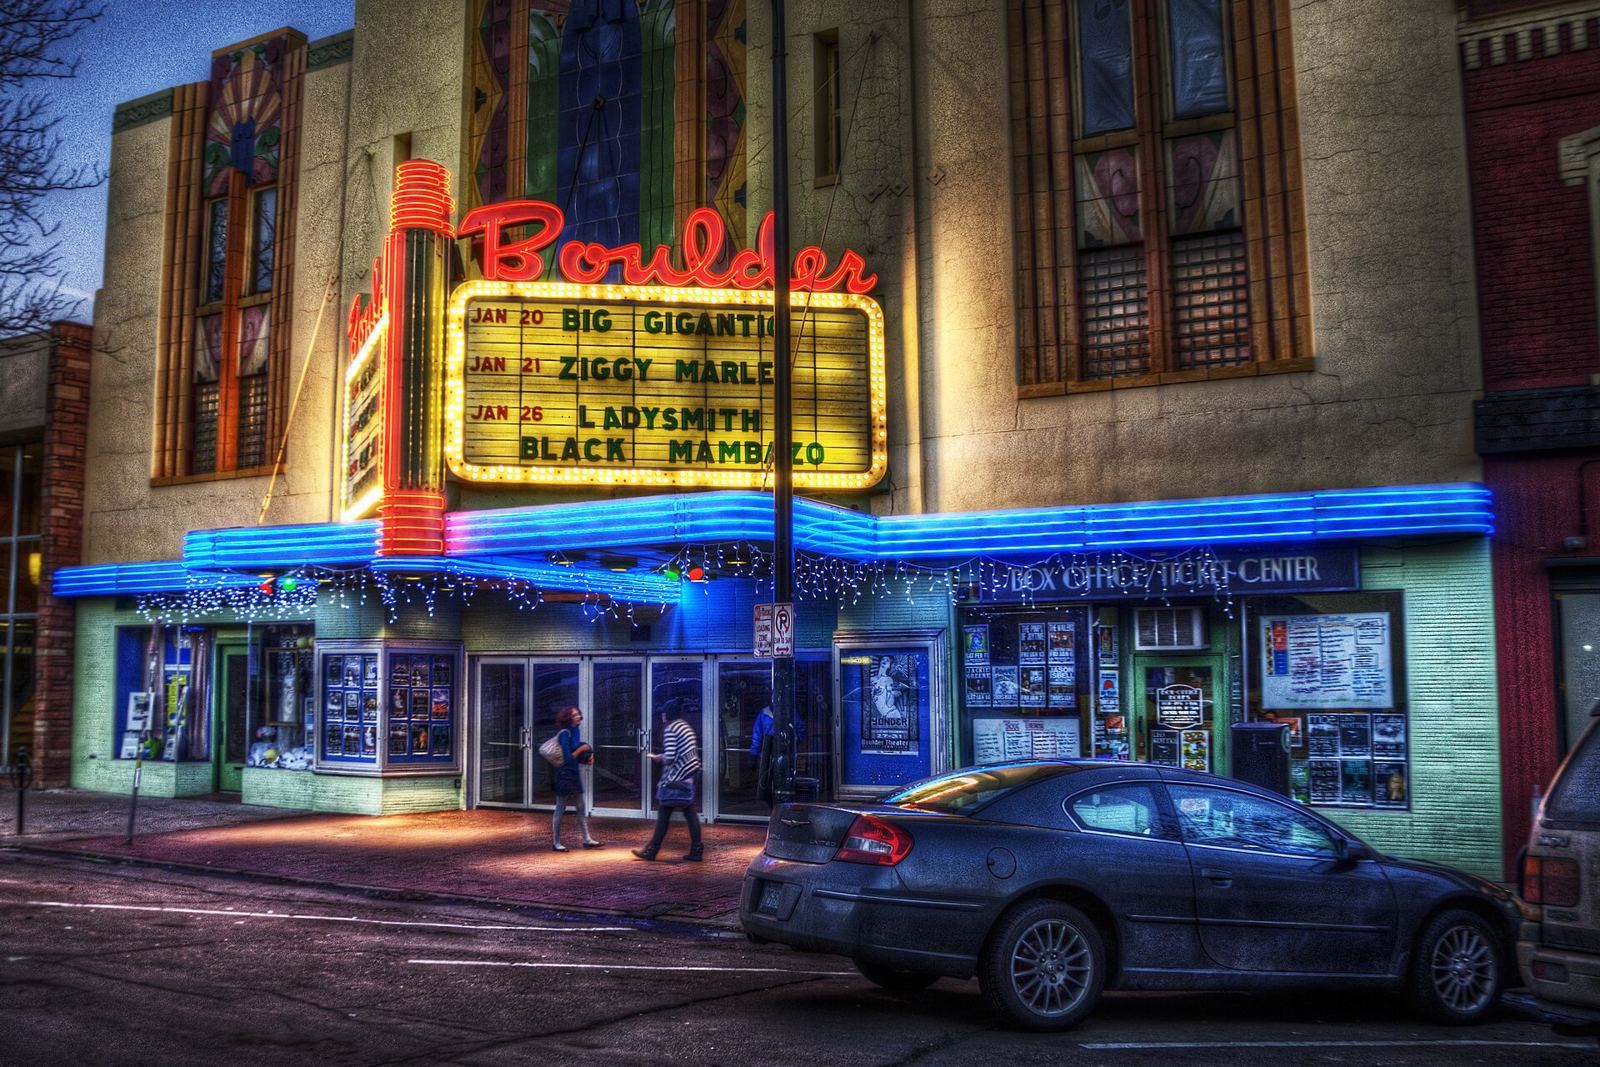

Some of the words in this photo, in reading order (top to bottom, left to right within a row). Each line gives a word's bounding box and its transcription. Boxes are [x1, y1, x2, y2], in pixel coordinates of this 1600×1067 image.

[457, 200, 879, 295] Boulder
[470, 307, 508, 325] JAN
[519, 309, 544, 325] 20
[562, 308, 613, 333] BIG
[469, 356, 507, 373] JAN
[522, 357, 541, 373] 21
[558, 356, 653, 382] ZIGGY
[675, 359, 775, 385] MARLE
[470, 404, 508, 421] JAN
[519, 406, 544, 422] 26
[578, 404, 760, 432] LADYSMITH
[520, 436, 627, 462] BLACK
[1011, 566, 1057, 592] BOX
[1238, 555, 1322, 583] CENTER
